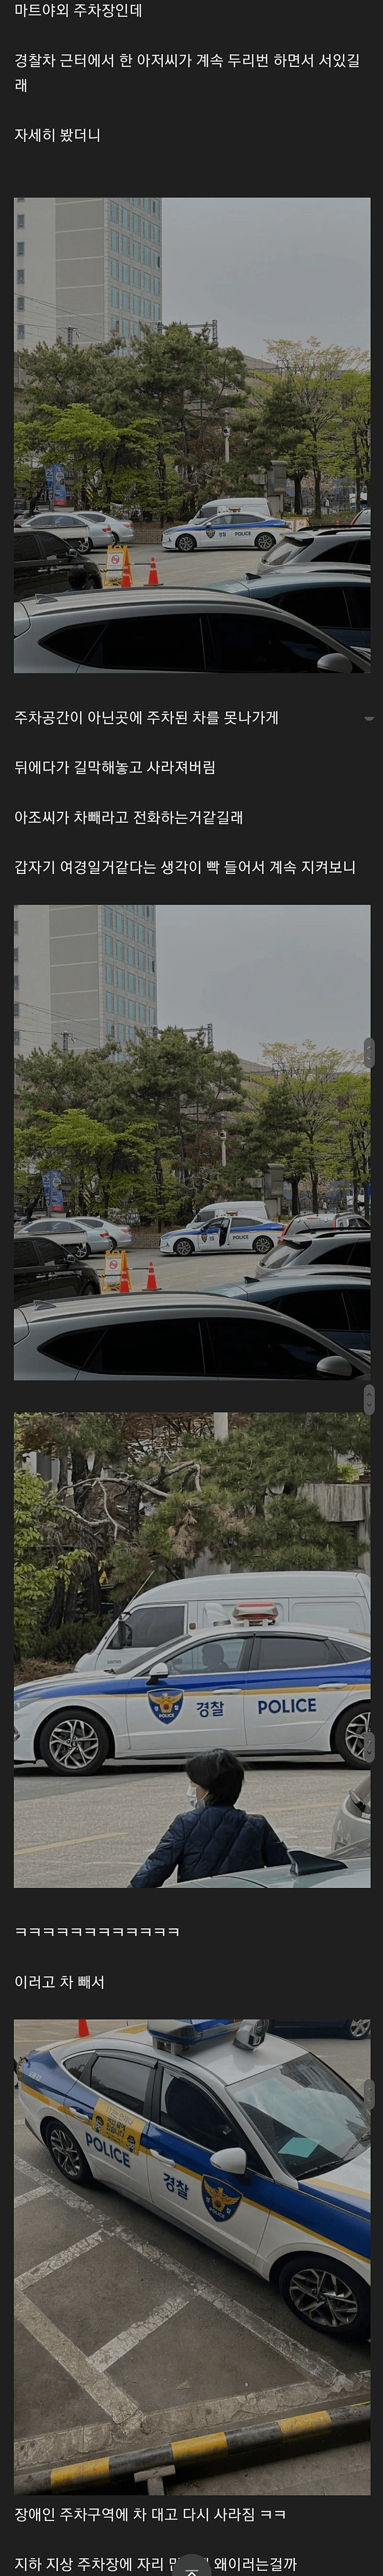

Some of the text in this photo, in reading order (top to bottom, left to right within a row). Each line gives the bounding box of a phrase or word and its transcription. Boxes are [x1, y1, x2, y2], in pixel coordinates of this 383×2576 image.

[197, 1701, 224, 1718] 경찰
[258, 1698, 316, 1714] POLICE
[85, 2132, 131, 2168] POLICE
[164, 2173, 189, 2200] 경찰
[209, 2207, 225, 2219] POLICE
